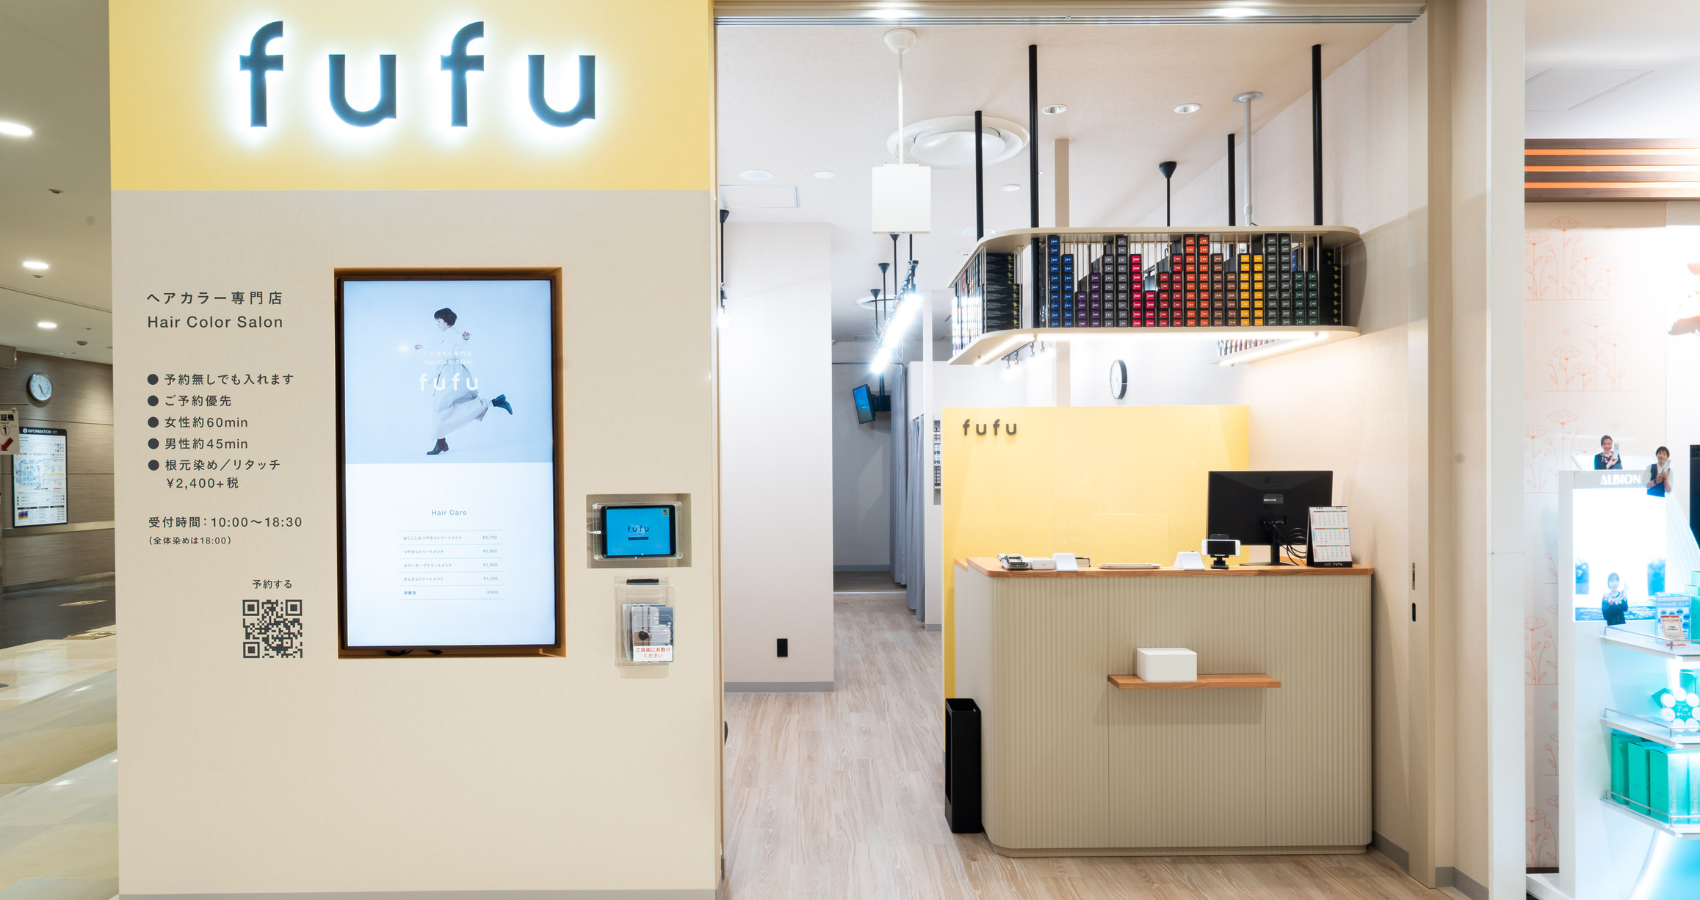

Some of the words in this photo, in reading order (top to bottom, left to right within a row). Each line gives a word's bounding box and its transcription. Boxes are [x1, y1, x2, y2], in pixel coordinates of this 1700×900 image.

[239, 20, 596, 128] fufu
[146, 291, 283, 305] ヘアカラー専門店
[147, 315, 181, 328] Hair
[186, 315, 231, 328] Color
[237, 315, 283, 328] Salon
[164, 373, 294, 386] 予約無しでも入れます
[419, 373, 479, 391] fufu
[165, 394, 232, 407] ご予約優先
[164, 416, 248, 428] 女性約60min
[962, 418, 1017, 435] fufu
[165, 437, 248, 450] 男性約45min
[1600, 473, 1642, 485] ALBION
[627, 525, 650, 533] fufu
[252, 579, 293, 589] 予約する
